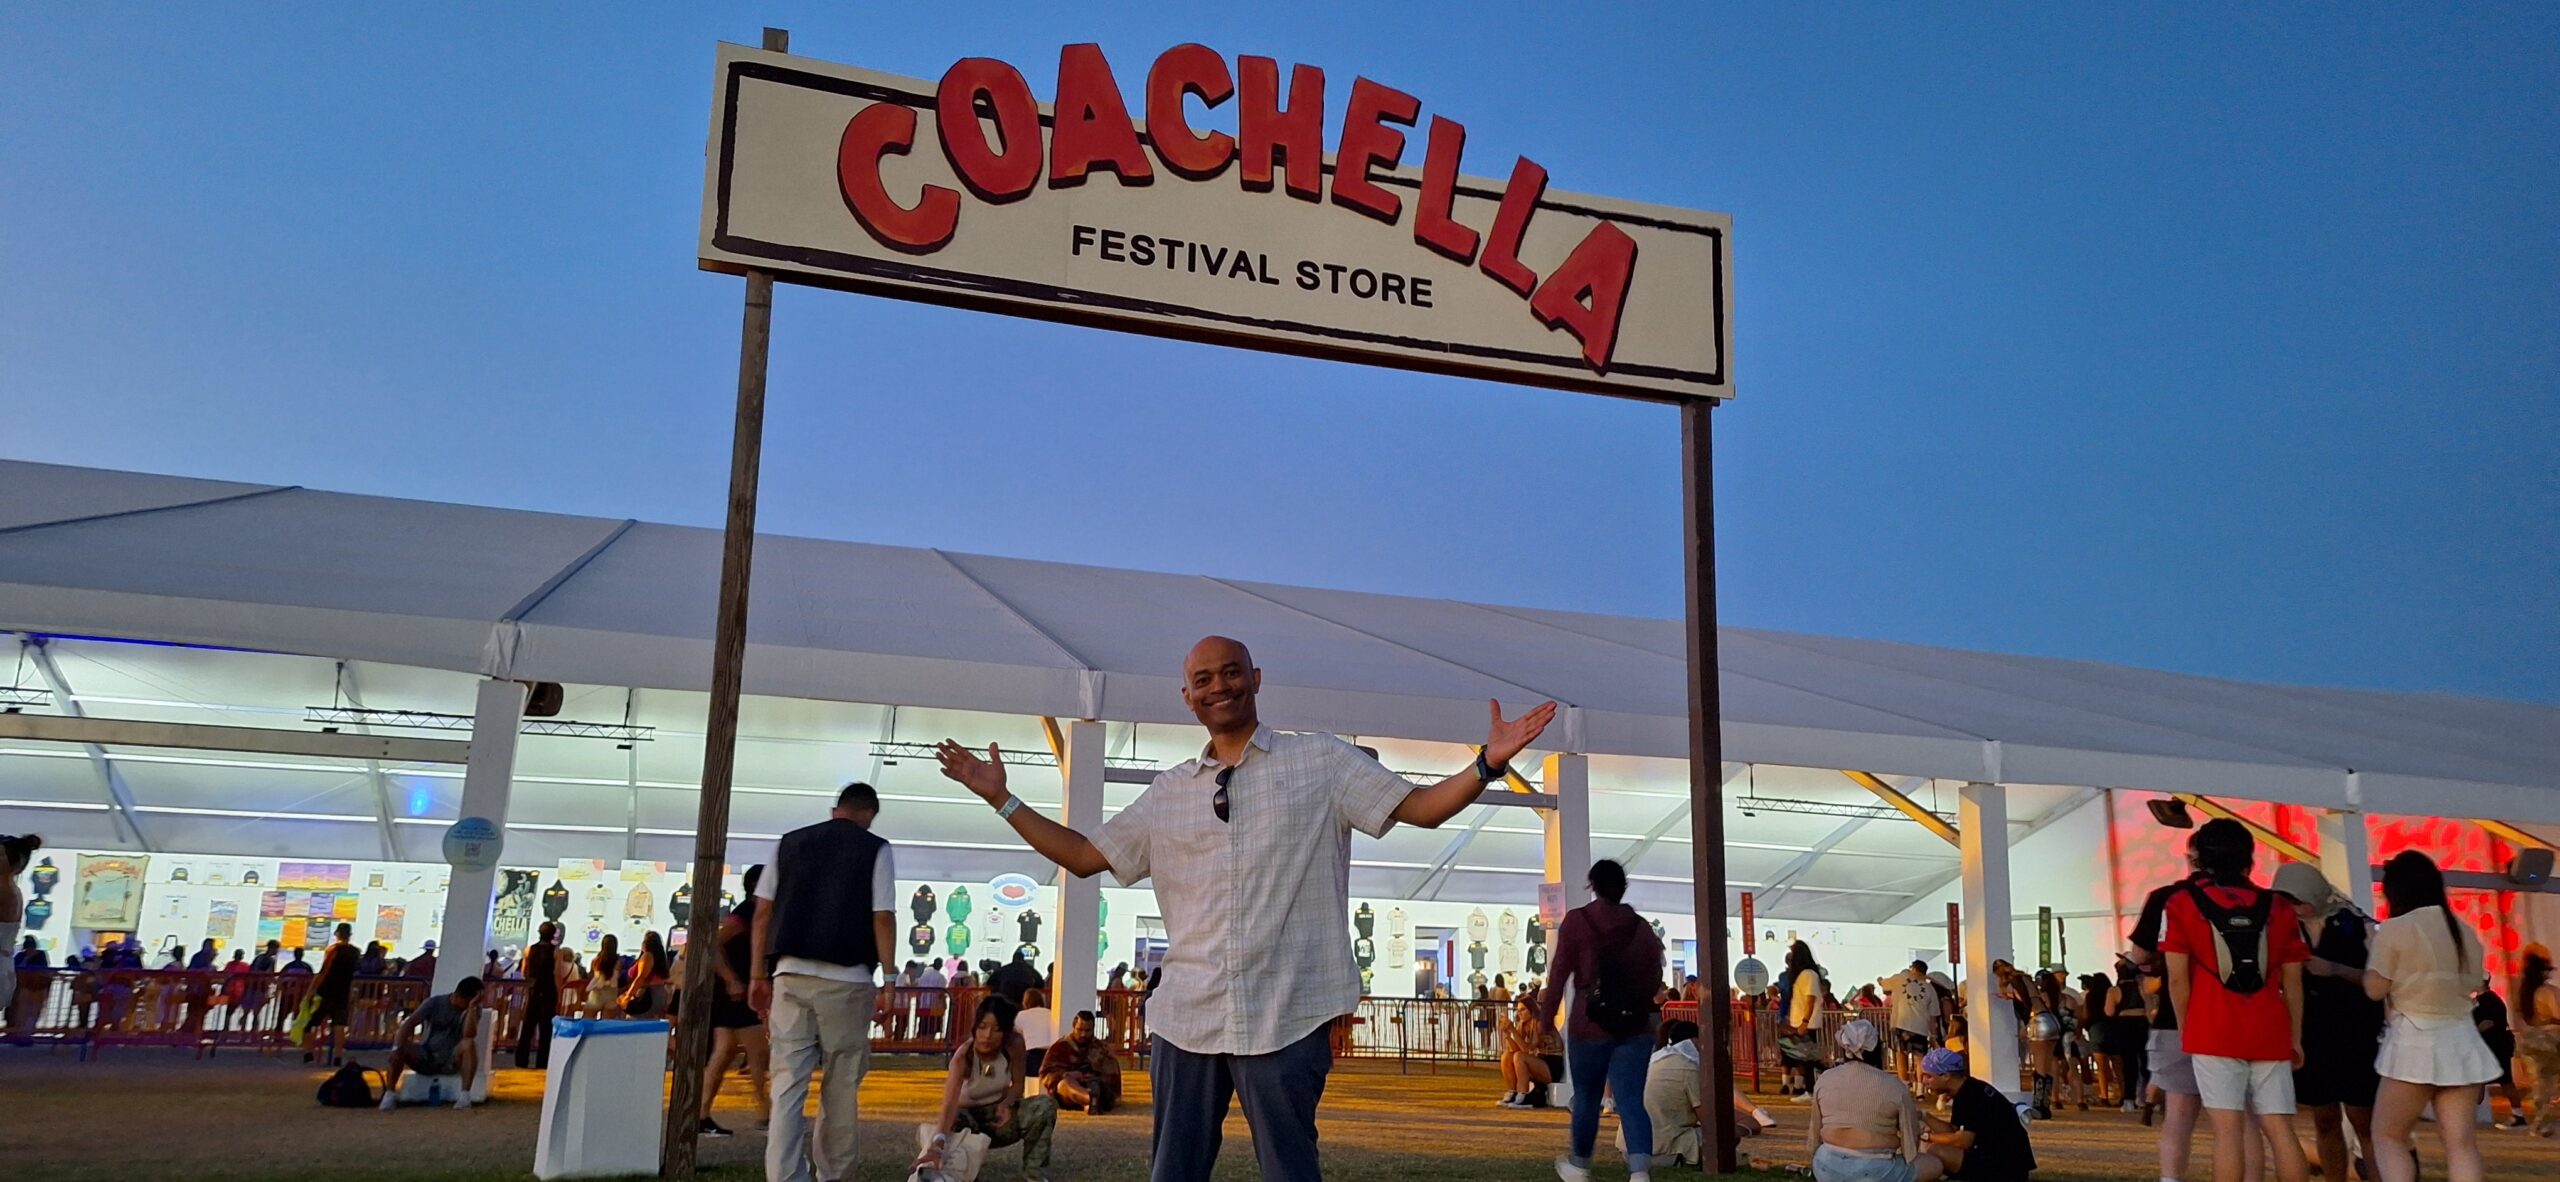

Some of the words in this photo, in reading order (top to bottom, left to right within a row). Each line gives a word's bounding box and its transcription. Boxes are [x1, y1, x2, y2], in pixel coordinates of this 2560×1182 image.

[837, 43, 1638, 374] COACHELLA
[1072, 225, 1280, 285] FESTIVAL
[1296, 260, 1433, 308] STORE
